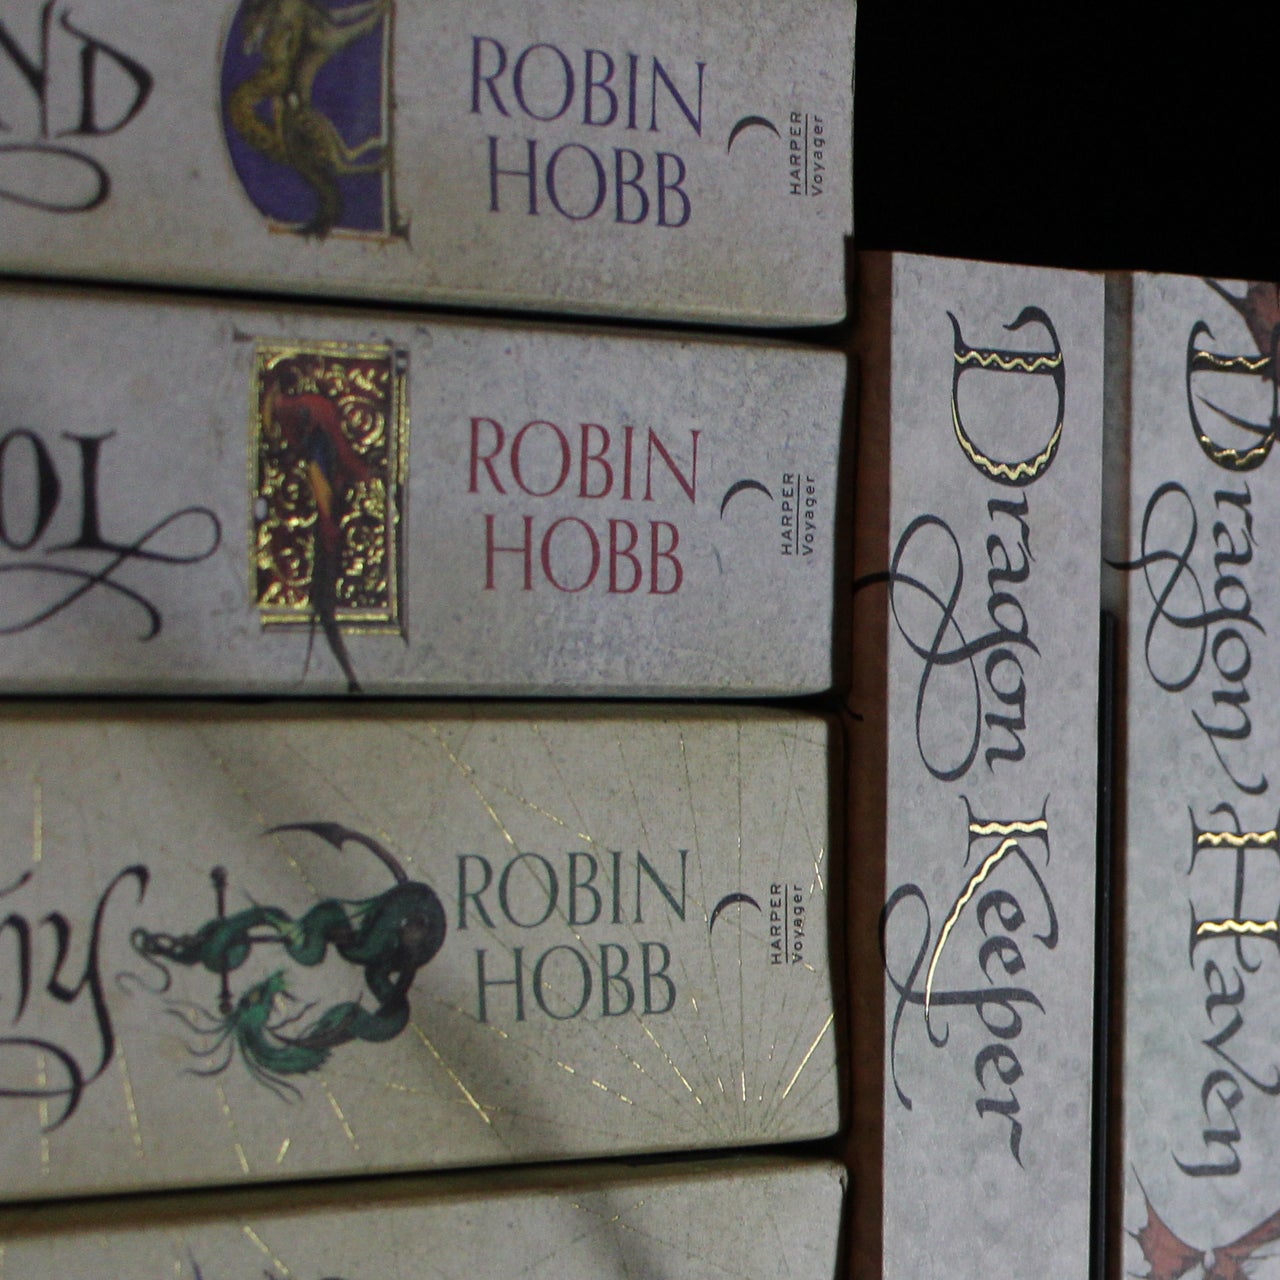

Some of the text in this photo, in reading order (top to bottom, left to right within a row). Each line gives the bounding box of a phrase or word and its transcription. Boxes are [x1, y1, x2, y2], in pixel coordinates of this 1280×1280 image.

[470, 36, 707, 138] ROBIN
[489, 136, 692, 228] HOBB
[790, 110, 802, 196] HARPER
[812, 114, 825, 197] Voyager
[467, 417, 701, 505] ROBIN
[484, 514, 684, 595] HOBB
[782, 472, 795, 556] HARPER
[803, 474, 815, 557] Voyager
[879, 305, 1066, 1171] Dragon Keeper
[456, 849, 690, 930] ROBIN
[771, 883, 783, 965] HARPER
[793, 884, 804, 965] Voyager
[476, 940, 677, 1023] HOBB
